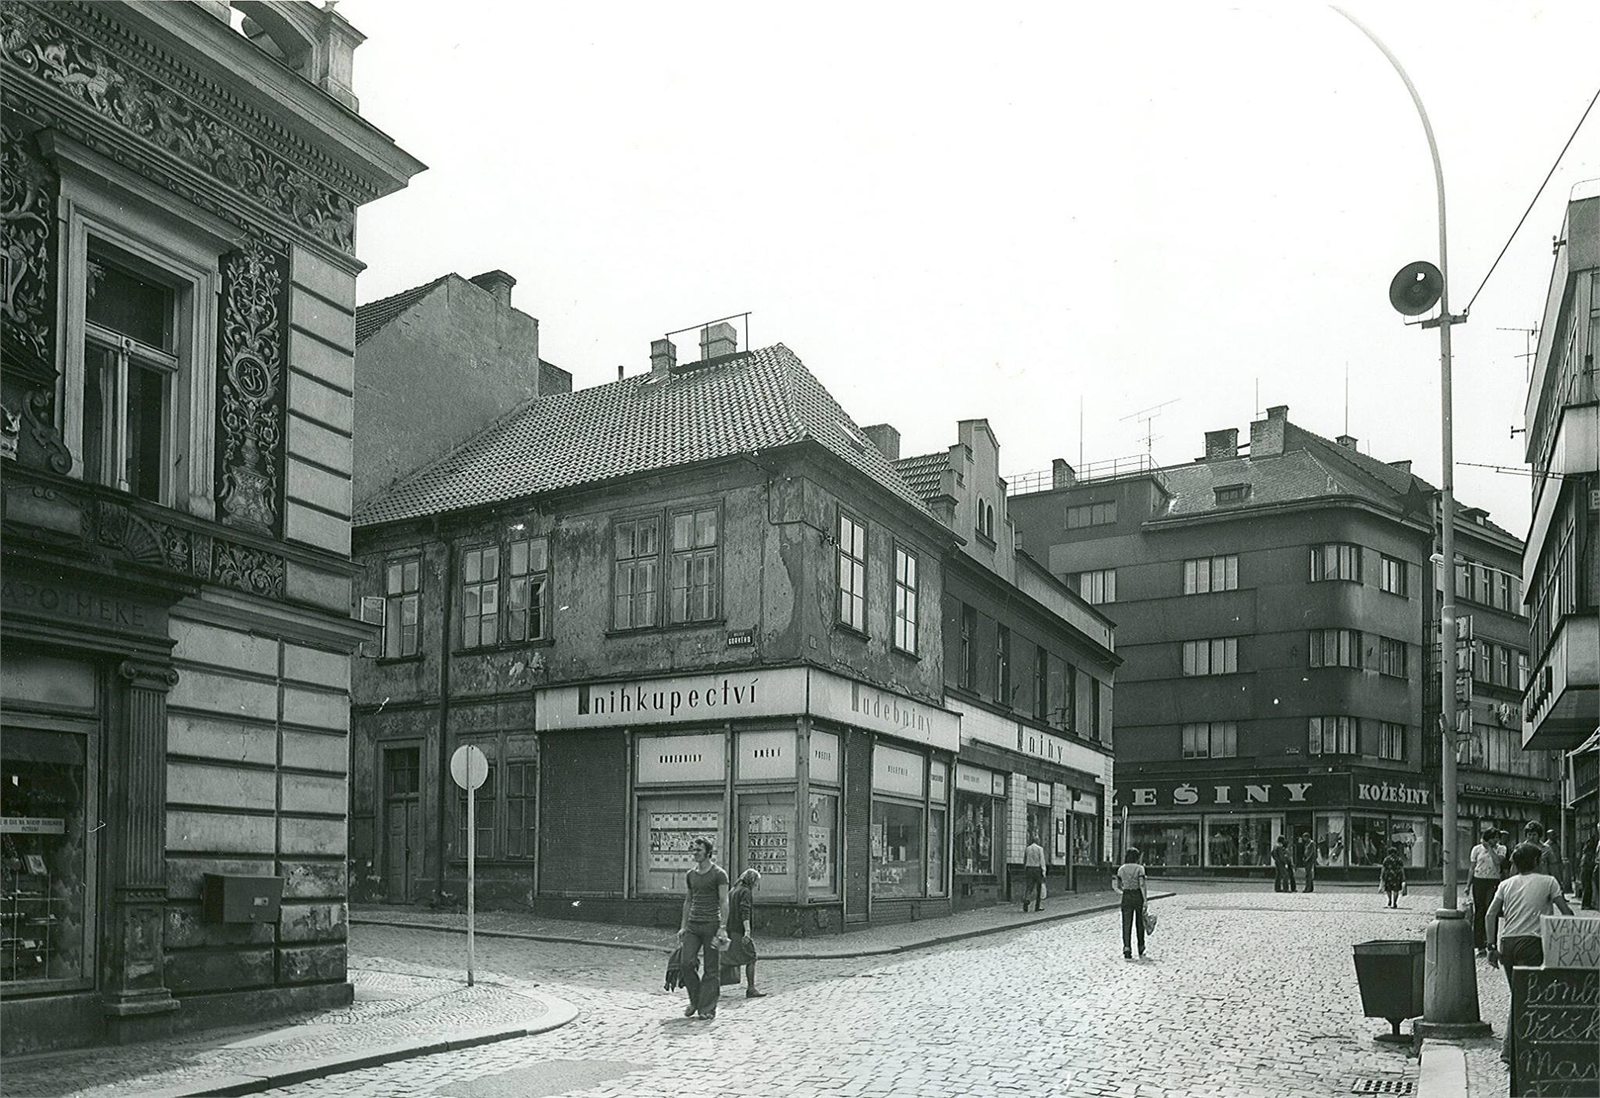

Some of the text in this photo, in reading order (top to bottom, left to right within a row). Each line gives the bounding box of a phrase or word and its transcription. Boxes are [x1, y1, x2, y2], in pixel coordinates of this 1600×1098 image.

[2, 581, 145, 627] APOTHEKE
[1112, 783, 1312, 806] EŠINY
[1358, 781, 1430, 805] KOŽEŠINY
